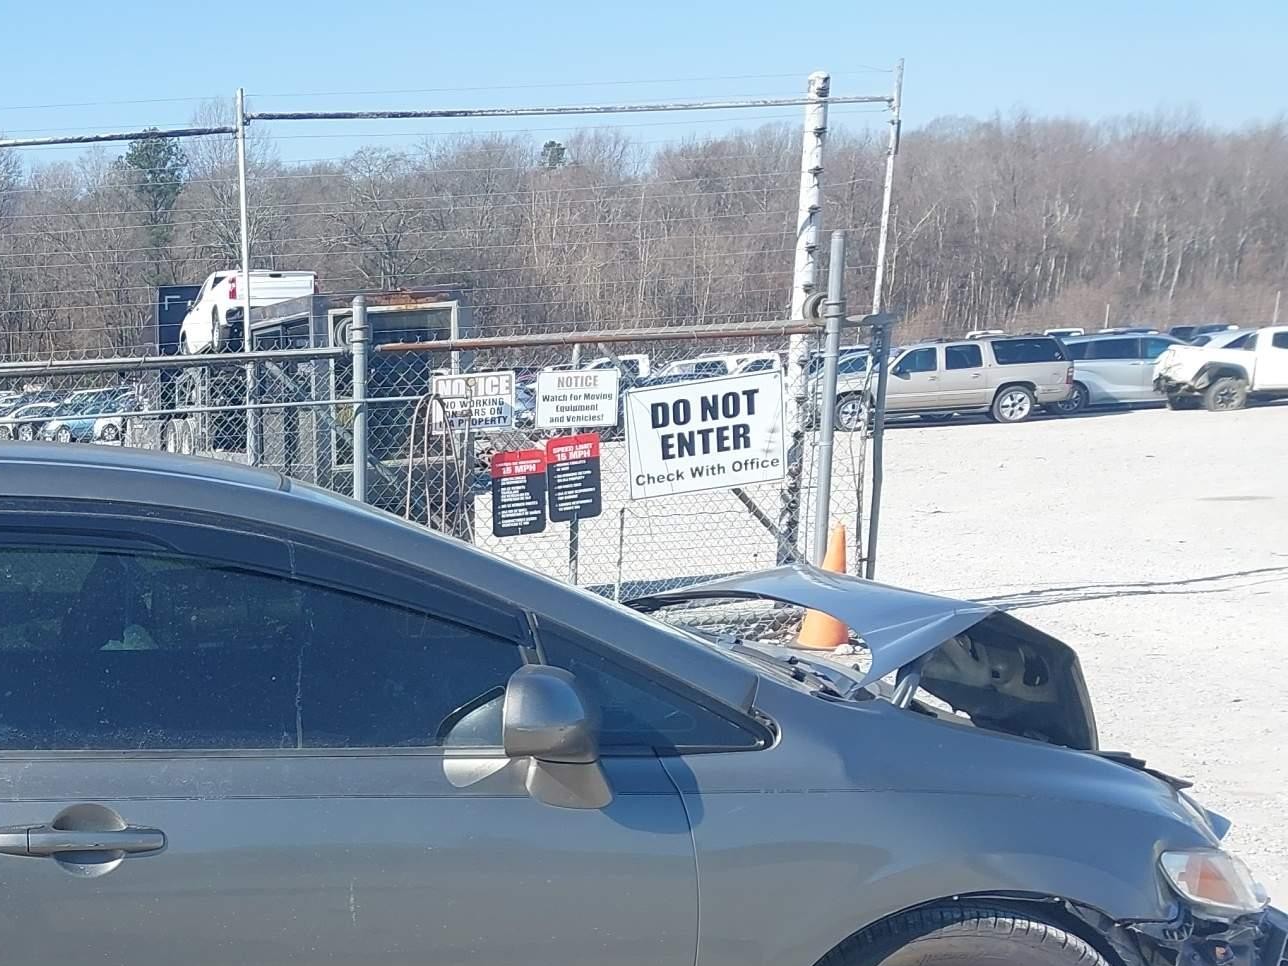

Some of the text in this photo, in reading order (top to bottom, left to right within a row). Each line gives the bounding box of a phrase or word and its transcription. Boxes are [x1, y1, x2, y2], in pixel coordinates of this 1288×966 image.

[556, 375, 599, 388] NOTICE
[460, 397, 505, 409] WORKING
[542, 392, 613, 402] Watch for Moving
[461, 408, 486, 417] ARS
[490, 406, 503, 416] ON
[555, 403, 598, 413] Equipment
[650, 388, 760, 429] DO NOT
[458, 415, 508, 427] POPERTY
[549, 415, 565, 423] and
[660, 423, 752, 461] ENTER
[556, 448, 591, 461] 15 MPH
[502, 466, 512, 475] 15
[514, 463, 536, 474] MPH
[635, 457, 780, 486] Check With Office
